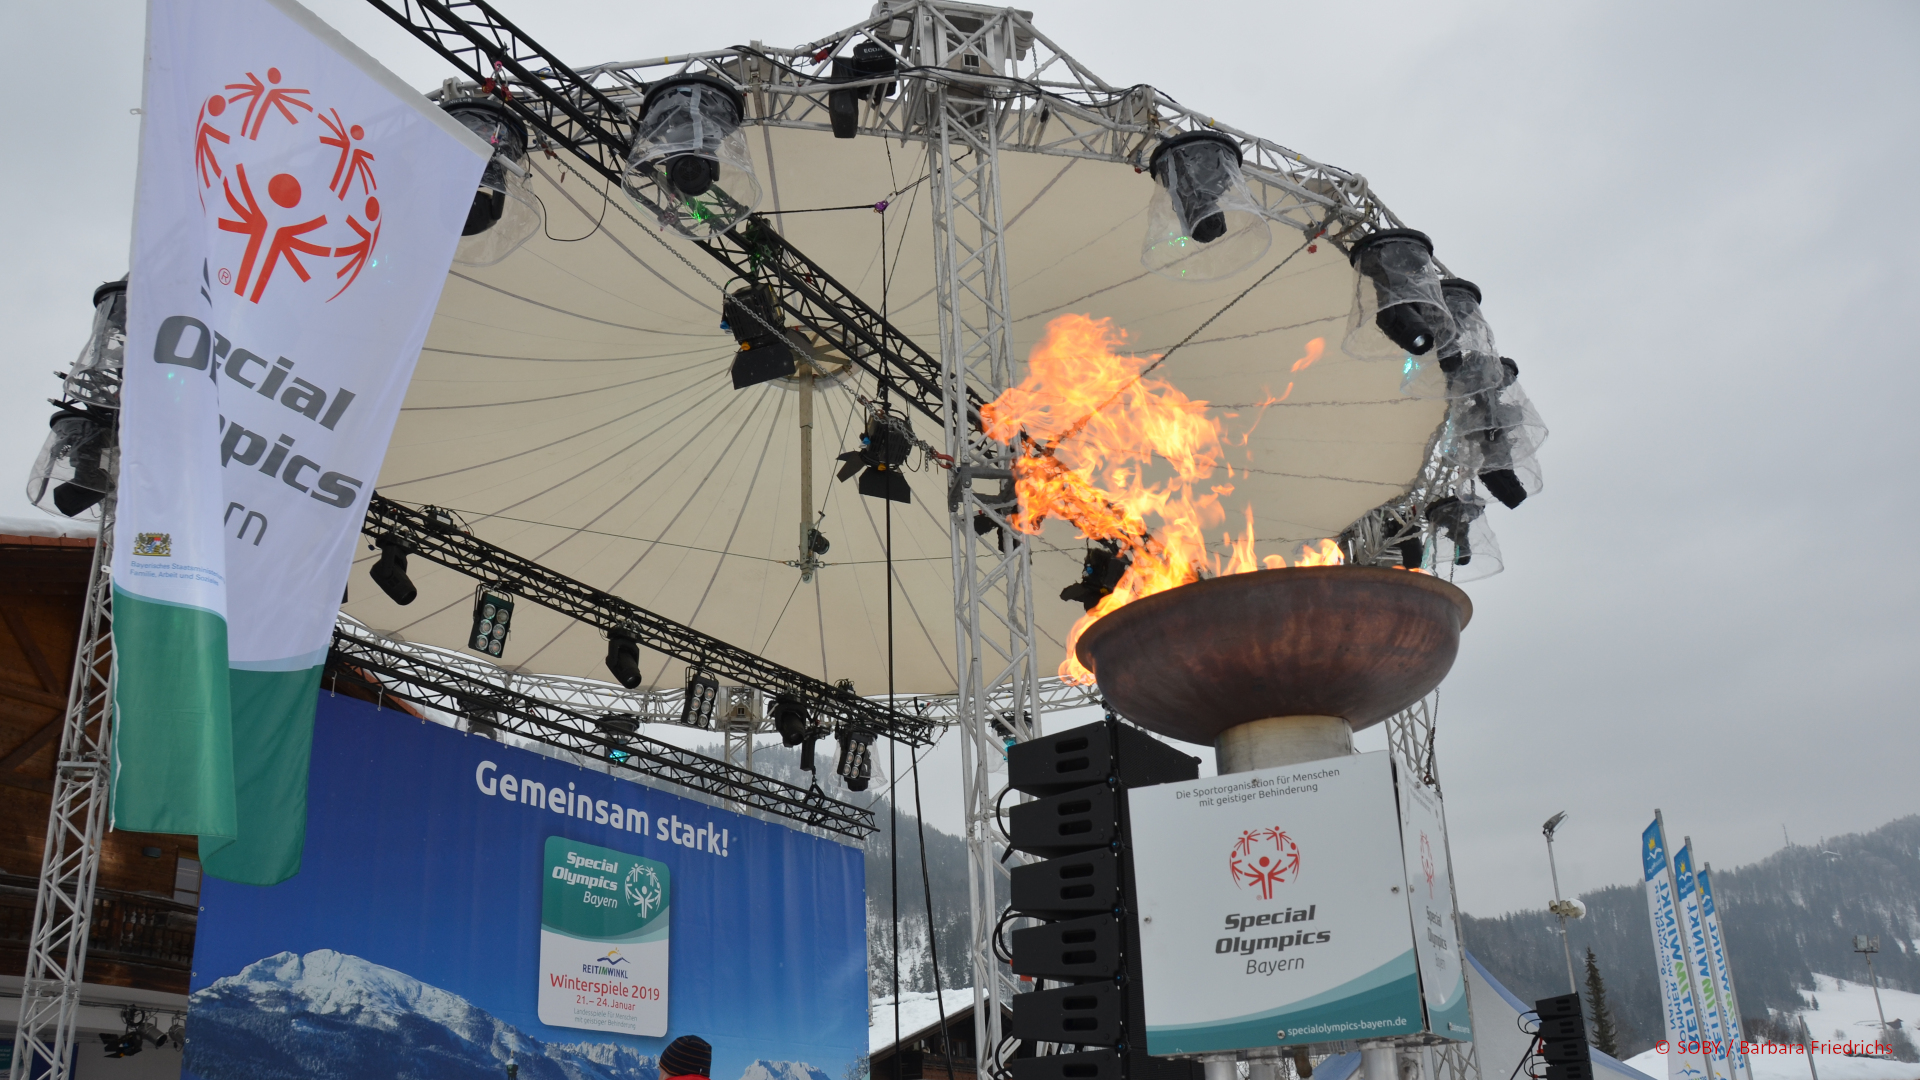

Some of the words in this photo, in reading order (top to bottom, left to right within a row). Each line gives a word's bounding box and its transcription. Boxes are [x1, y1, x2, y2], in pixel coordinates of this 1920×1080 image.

[158, 571, 178, 579] Arbeit
[1175, 791, 1192, 800] Die
[1193, 778, 1275, 798] Sportorganisation
[1276, 775, 1290, 785] für
[1292, 768, 1341, 783] Menschen
[1199, 797, 1215, 807] mit
[1216, 792, 1257, 807] geistiger
[1258, 782, 1318, 799] Behinderung
[475, 760, 649, 835] Gemeinsam
[657, 815, 728, 857] stark!
[567, 851, 619, 874] Special
[552, 866, 618, 891] Olympics
[583, 891, 618, 909] Bayern
[1224, 904, 1316, 932] Special
[1215, 928, 1331, 956] Olympics
[1246, 956, 1305, 977] Bayern
[550, 973, 629, 998] Winterspiele
[631, 985, 660, 1001] 2019
[1287, 1016, 1408, 1037] specialolympics-bayern.de
